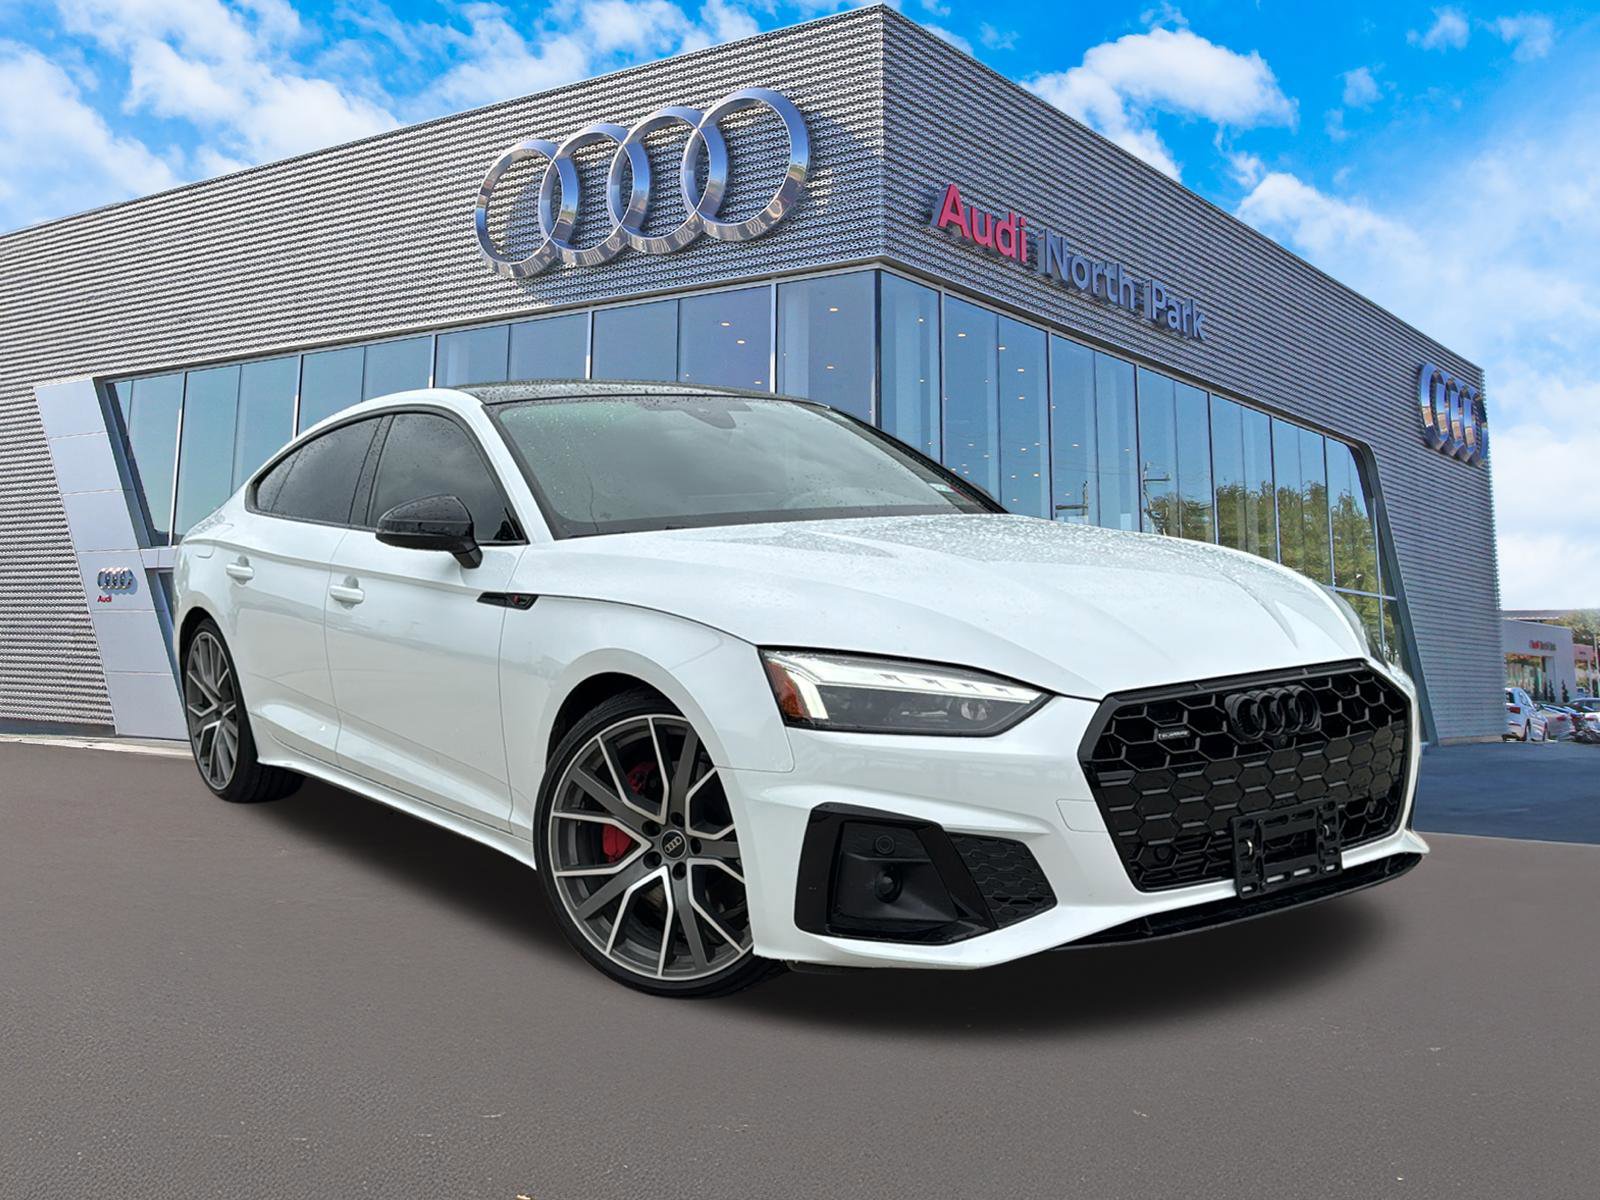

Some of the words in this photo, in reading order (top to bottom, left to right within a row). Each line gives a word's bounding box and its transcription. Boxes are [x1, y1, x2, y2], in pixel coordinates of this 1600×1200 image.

[936, 183, 1028, 264] Audi
[1041, 229, 1137, 311] North
[1147, 279, 1207, 341] Park
